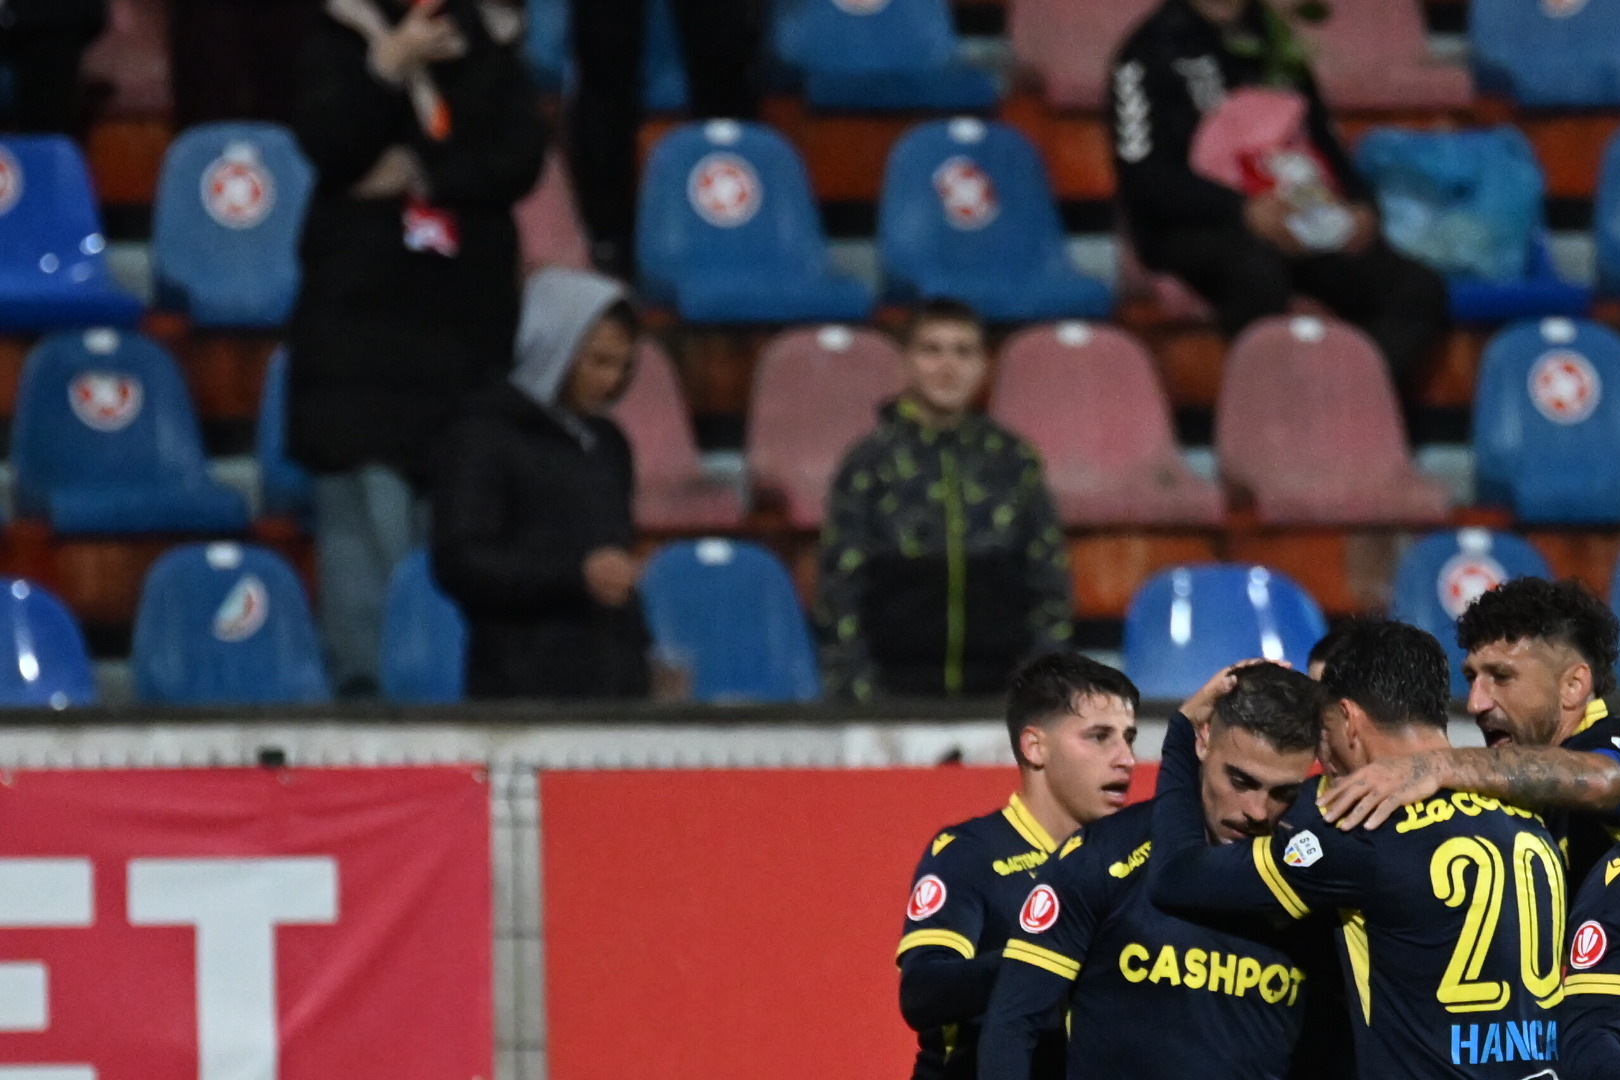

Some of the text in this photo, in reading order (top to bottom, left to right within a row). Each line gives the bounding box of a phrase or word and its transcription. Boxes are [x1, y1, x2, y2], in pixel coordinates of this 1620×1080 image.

[1430, 832, 1566, 1013] 20
[1118, 942, 1307, 1007] CASHPOT
[1451, 1019, 1559, 1065] HANCA
